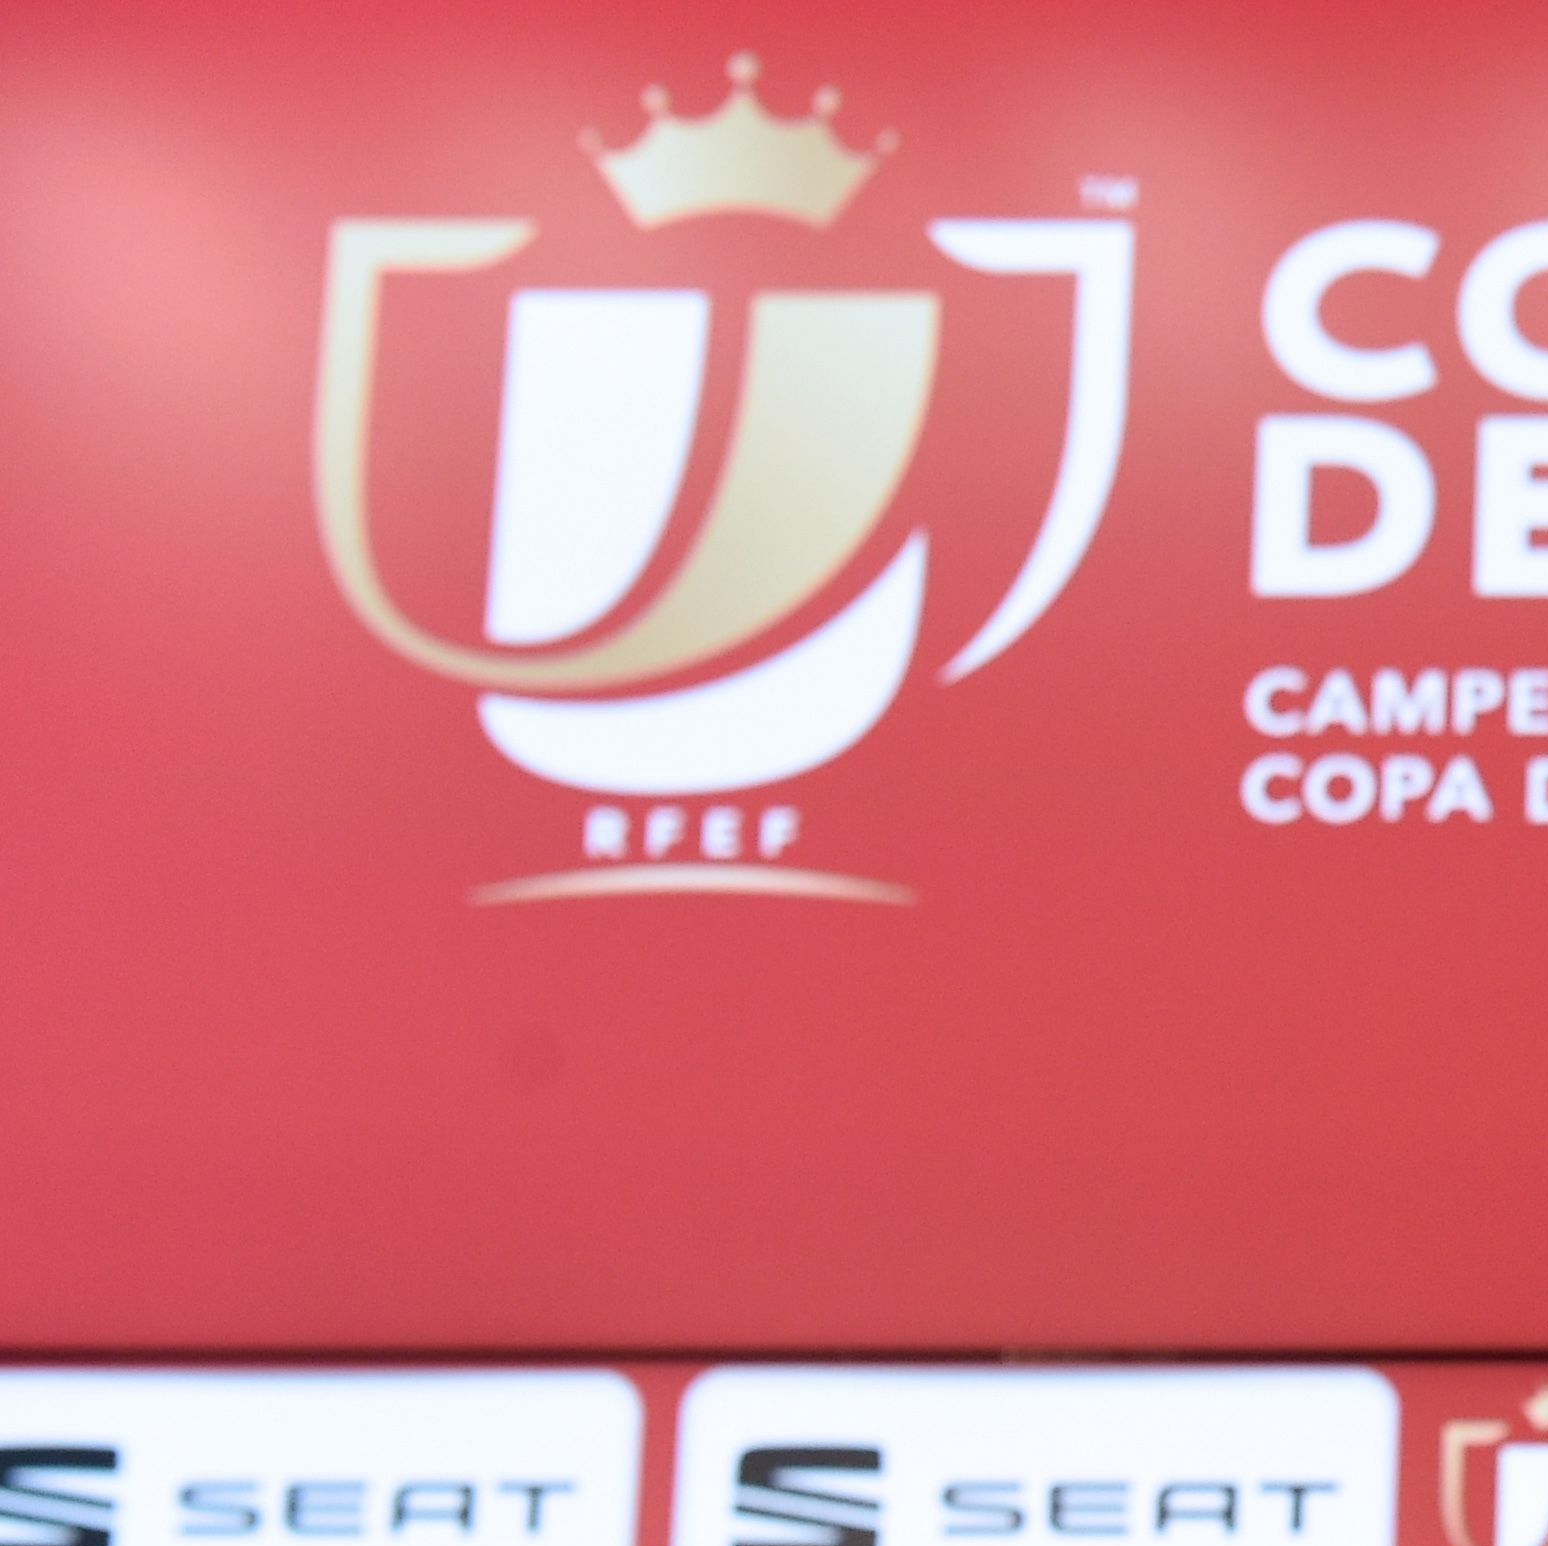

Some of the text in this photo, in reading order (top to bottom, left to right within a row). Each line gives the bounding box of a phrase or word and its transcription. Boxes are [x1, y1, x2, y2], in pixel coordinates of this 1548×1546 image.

[1242, 755, 1491, 823] COPA
[585, 808, 797, 860] RFEF
[177, 1480, 574, 1536] SEAT
[939, 1481, 1337, 1536] SEAT
